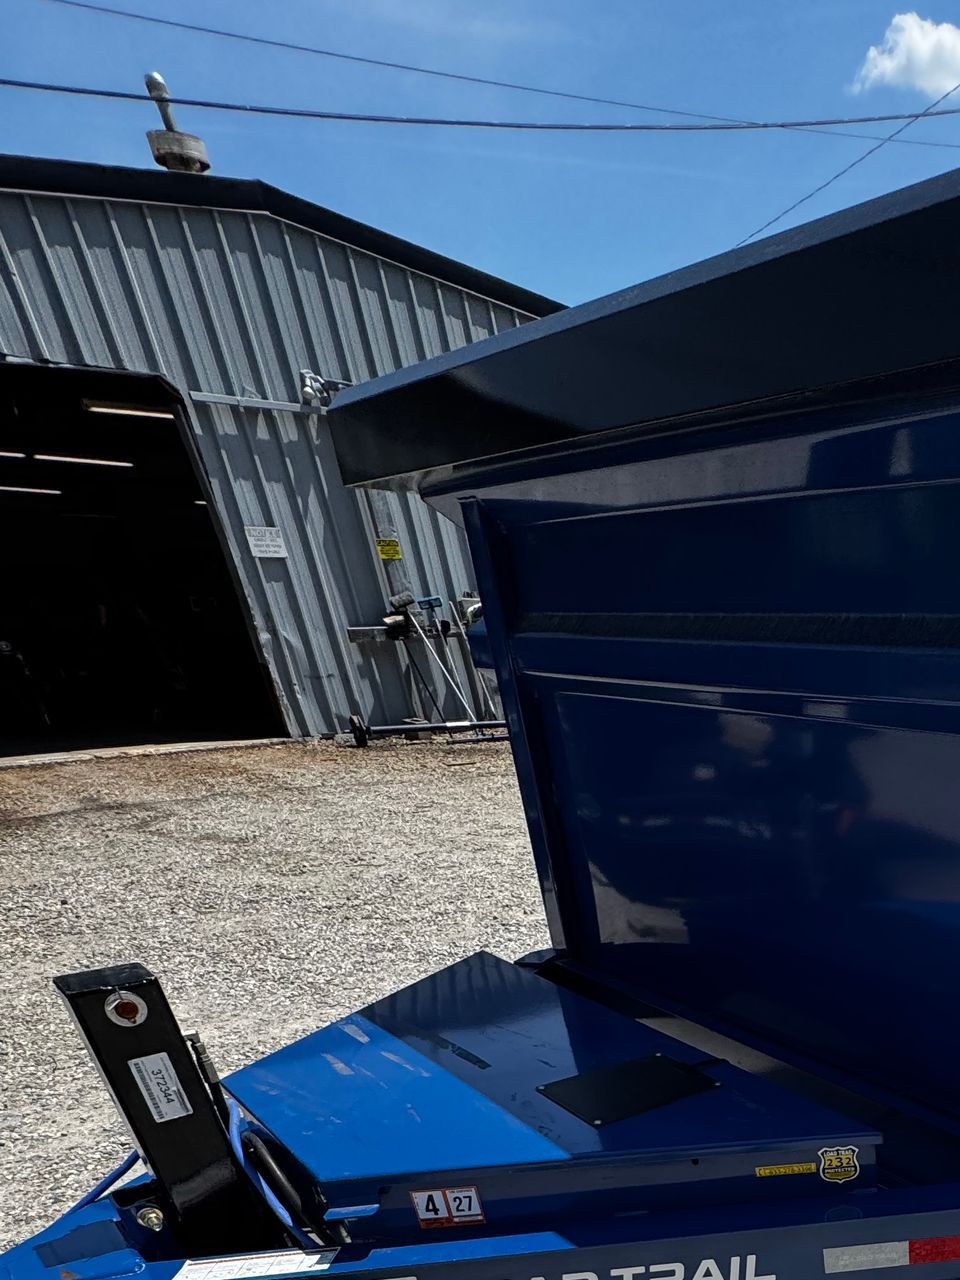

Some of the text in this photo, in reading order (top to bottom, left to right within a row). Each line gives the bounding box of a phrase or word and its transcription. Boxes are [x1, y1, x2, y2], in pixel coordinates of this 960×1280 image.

[151, 1068, 176, 1104] 372344
[425, 1194, 473, 1216] 4 27
